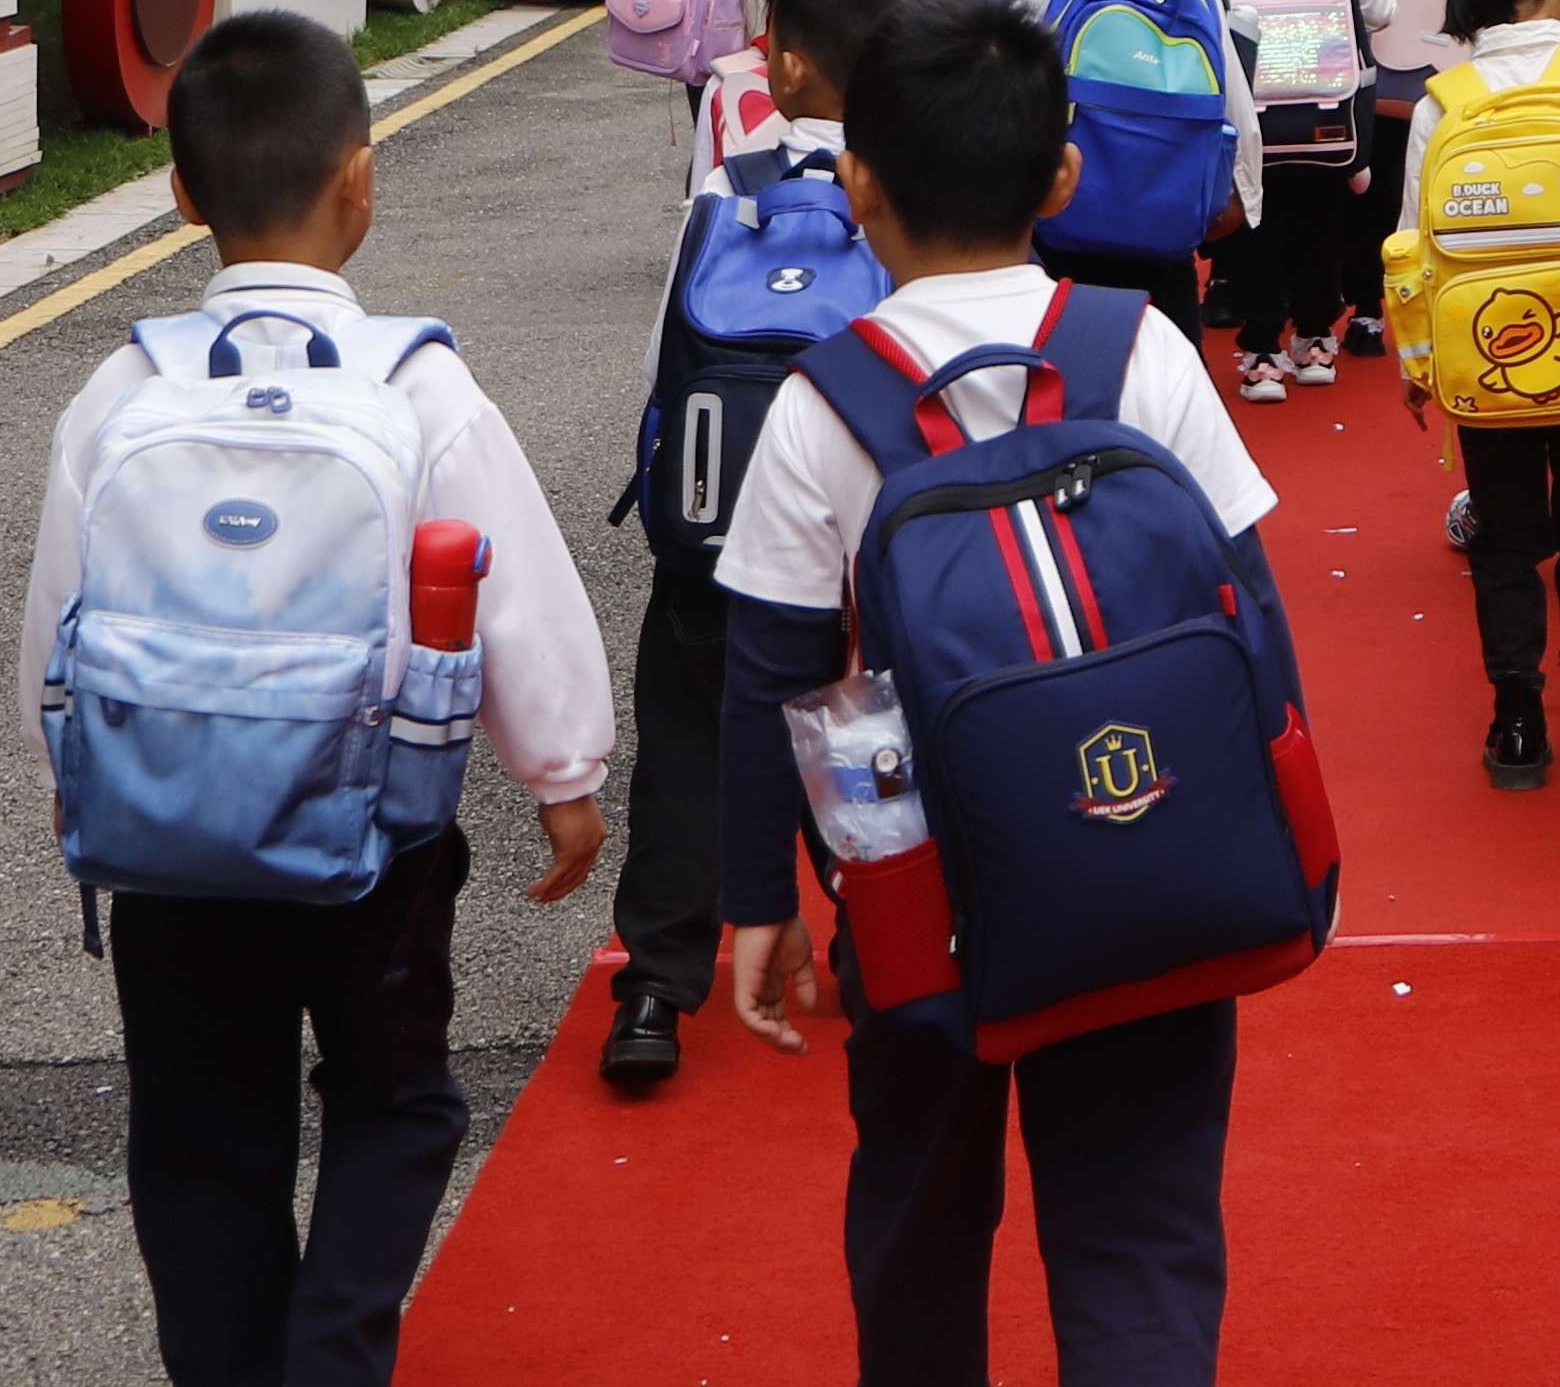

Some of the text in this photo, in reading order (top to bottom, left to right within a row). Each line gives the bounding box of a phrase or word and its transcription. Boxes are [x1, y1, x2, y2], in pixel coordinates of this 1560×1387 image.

[1452, 182, 1501, 198] B.DUCK
[1444, 196, 1509, 217] OCEAN
[1095, 748, 1139, 797] U
